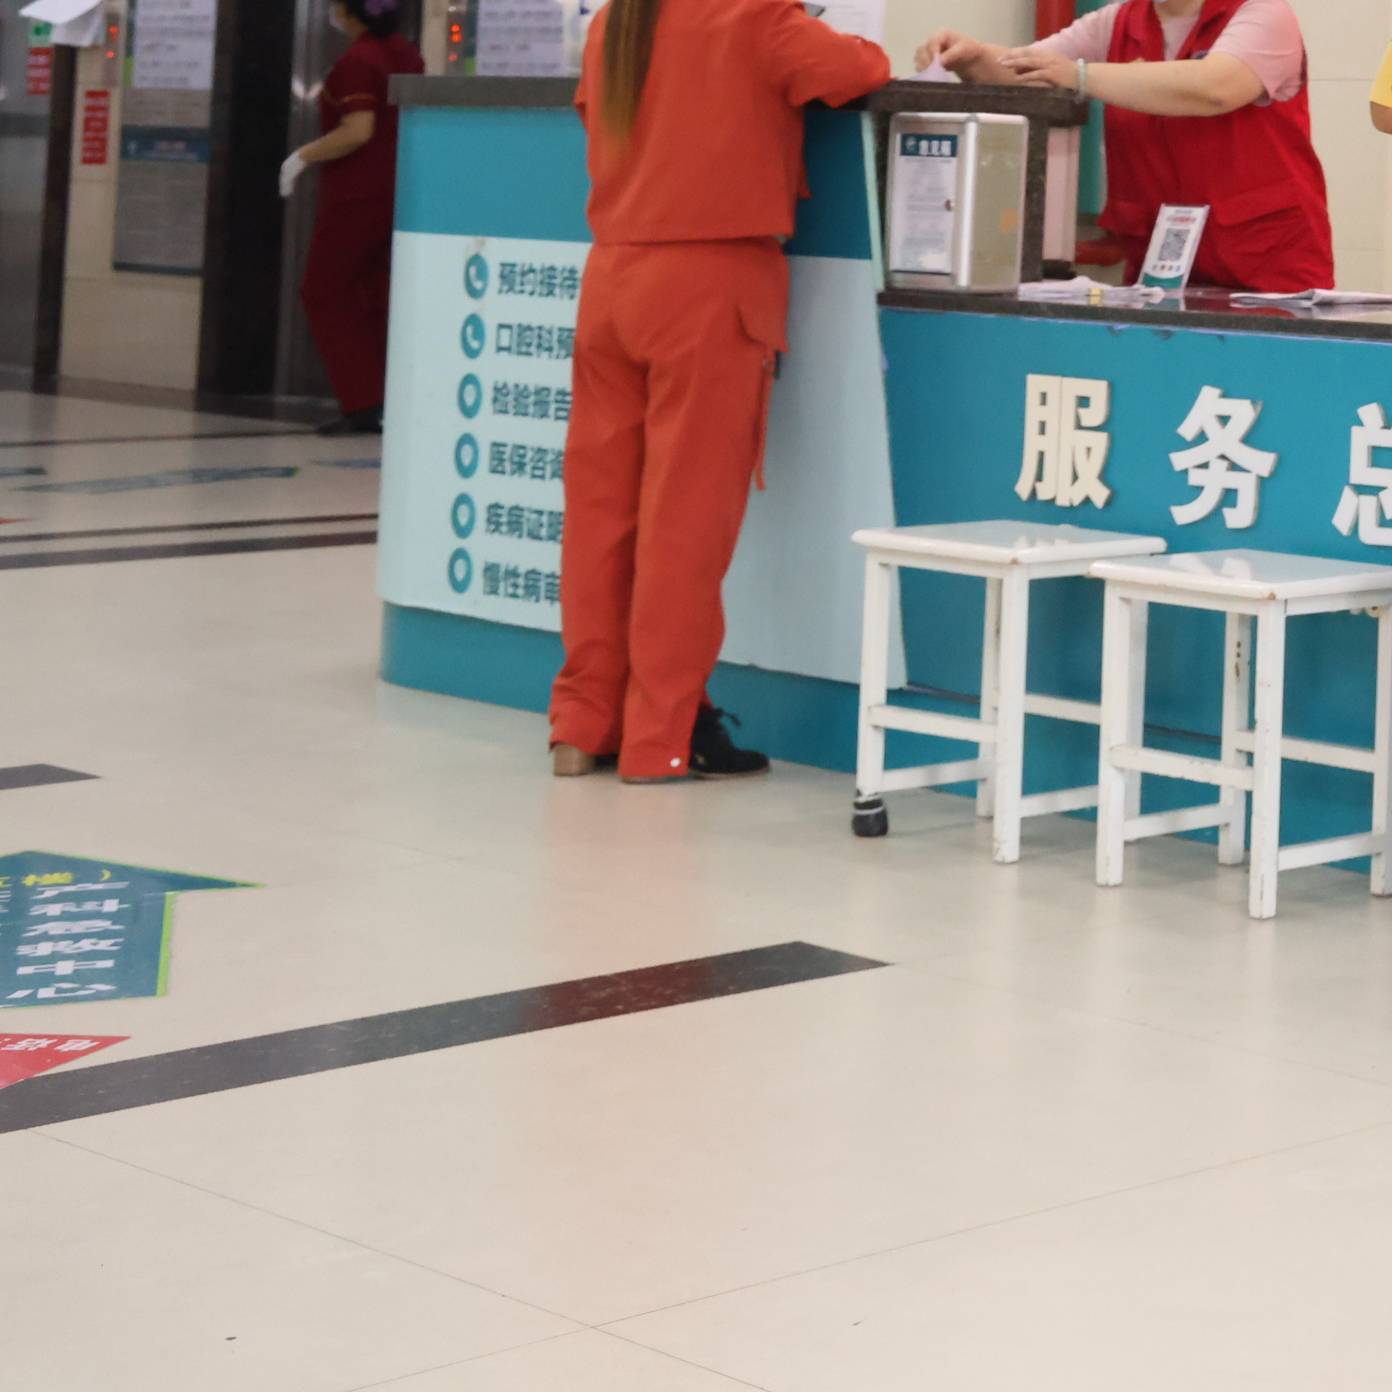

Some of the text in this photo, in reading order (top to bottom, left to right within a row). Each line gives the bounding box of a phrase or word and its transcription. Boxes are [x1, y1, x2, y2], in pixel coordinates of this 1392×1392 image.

[497, 260, 580, 302] 预约接待
[495, 322, 576, 361] 口腔科预
[491, 380, 572, 423] 检验报告
